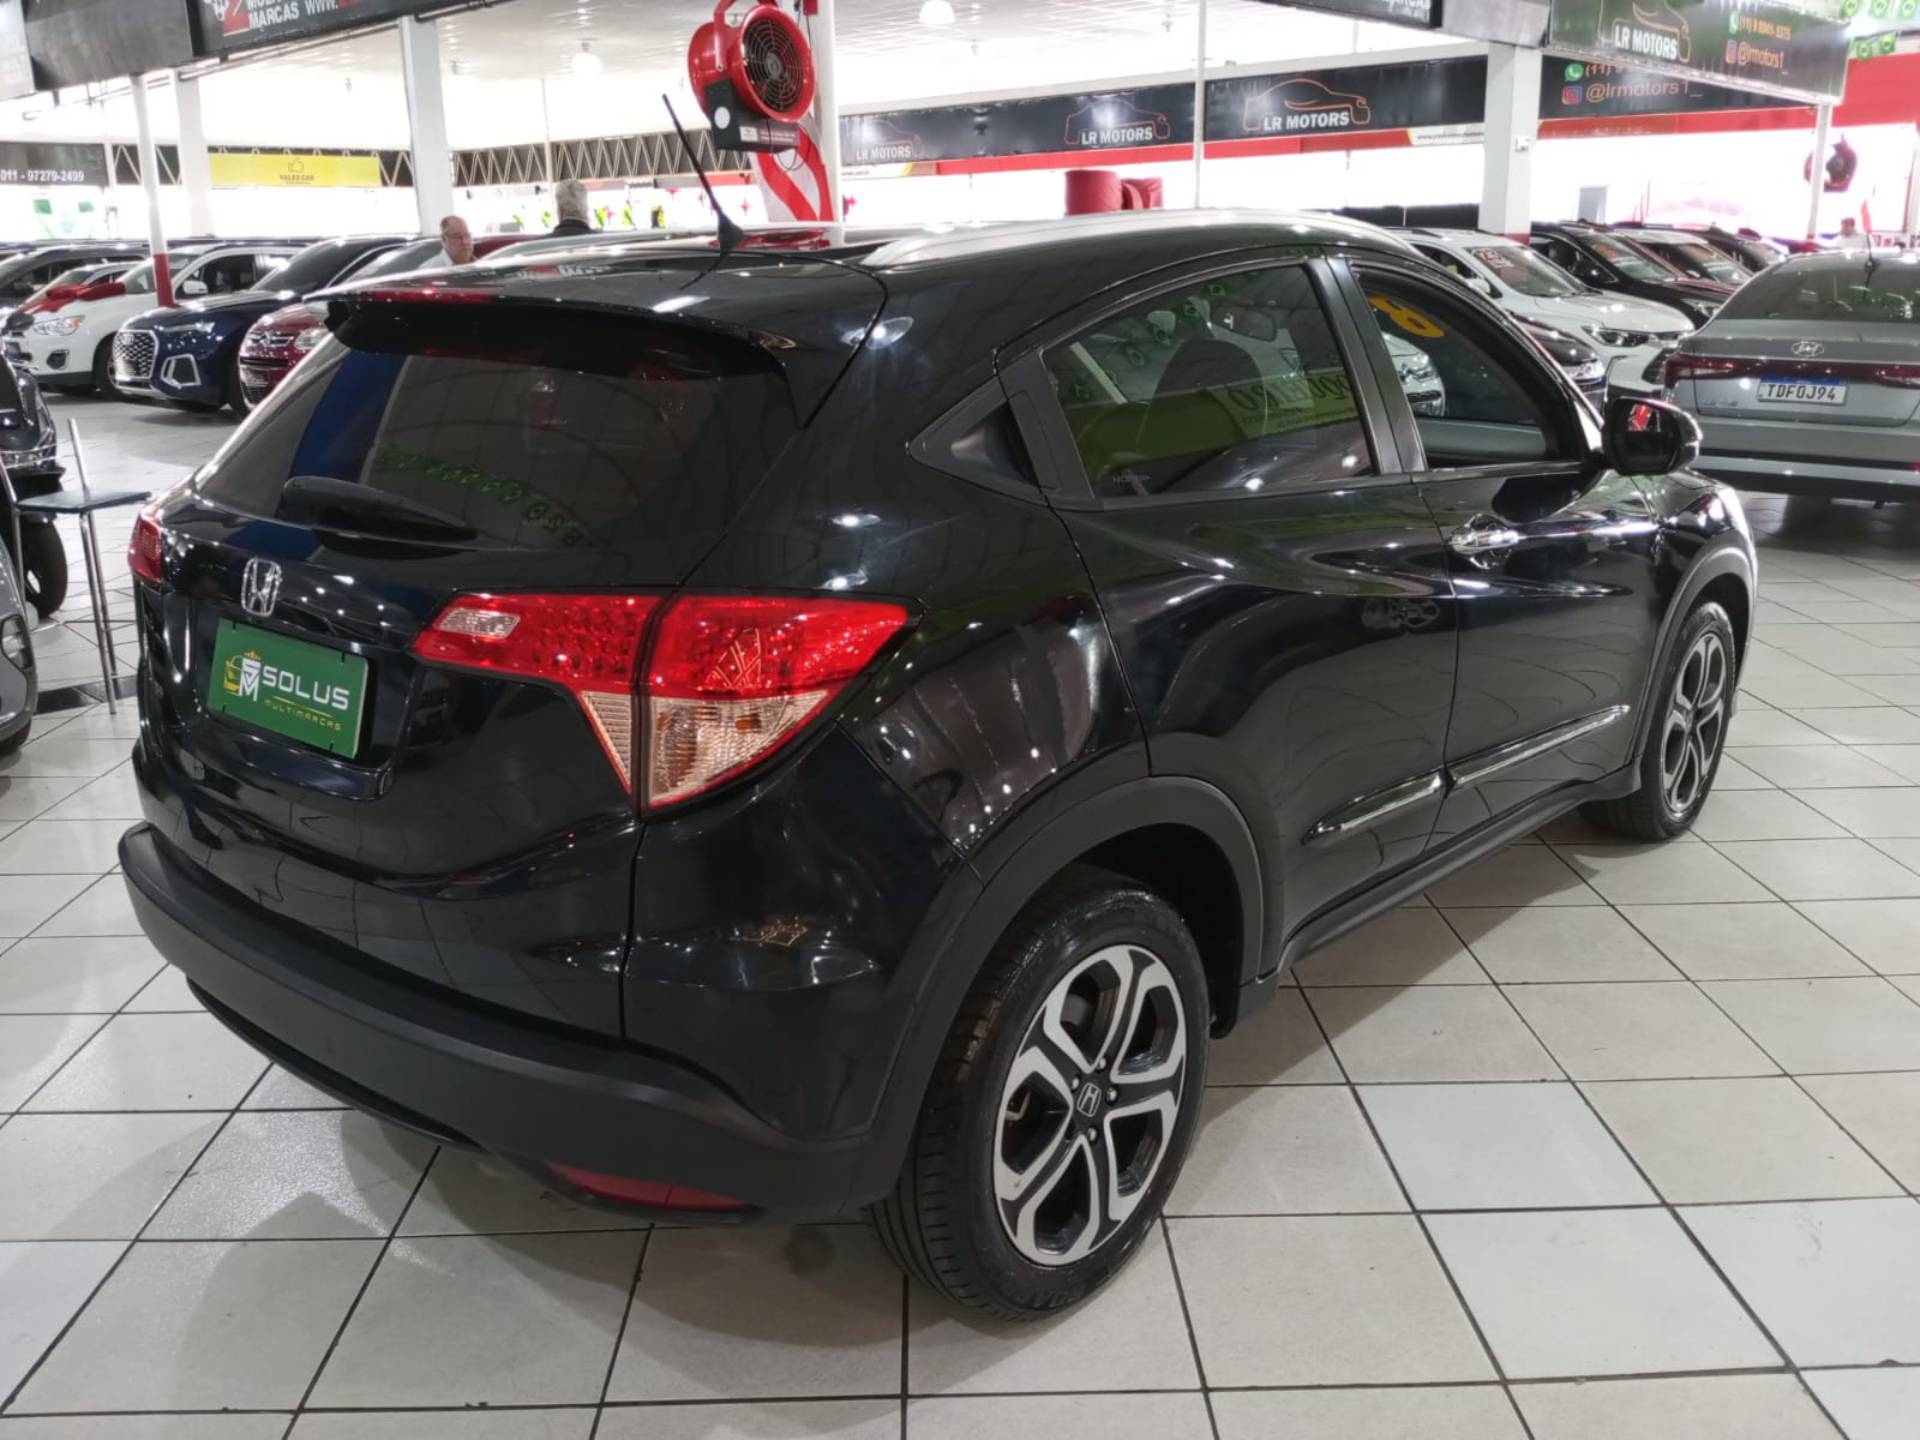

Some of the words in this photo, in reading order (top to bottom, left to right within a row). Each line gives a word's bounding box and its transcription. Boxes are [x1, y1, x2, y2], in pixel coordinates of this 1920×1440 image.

[249, 2, 299, 28] MARCAS
[1614, 24, 1630, 50] LR
[1632, 28, 1678, 61] MOTORS
[1263, 115, 1282, 131] LR
[1286, 111, 1349, 129] MOTORS
[1081, 131, 1097, 145] LR
[1100, 126, 1153, 145] MOTORS
[856, 148, 869, 160] LR
[871, 145, 912, 160] MOTORS
[261, 665, 350, 711] SOLUS
